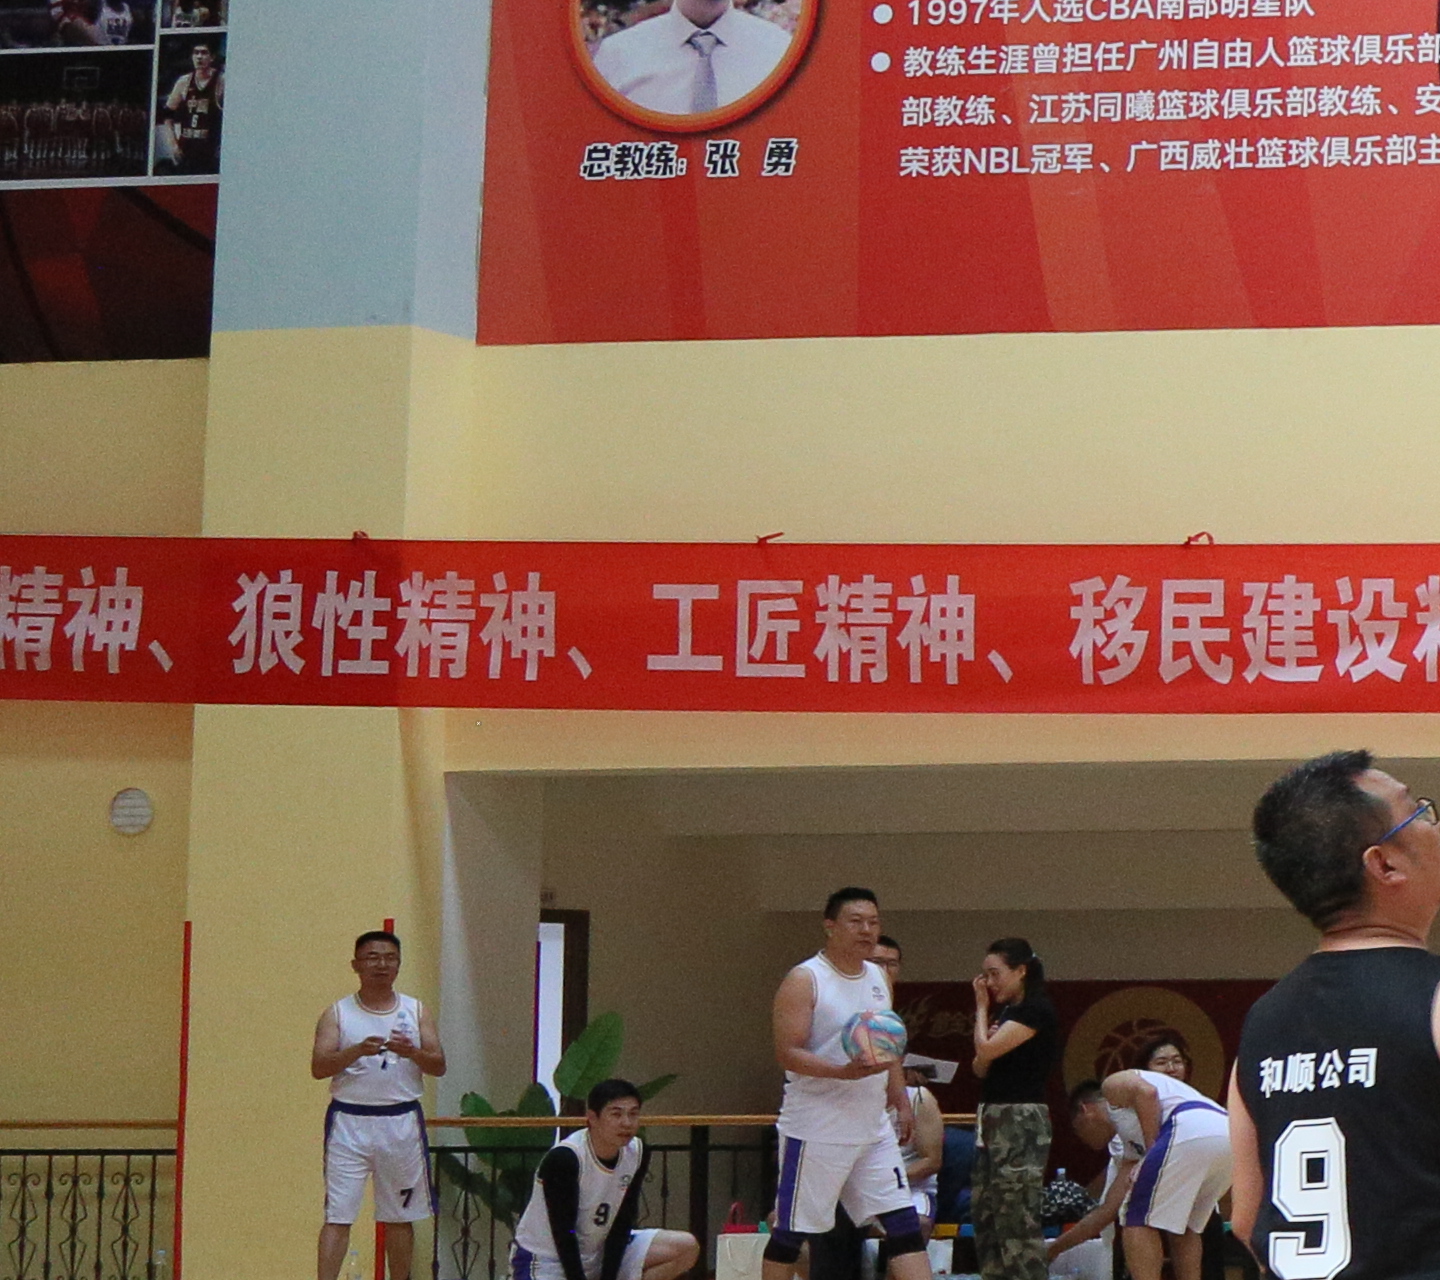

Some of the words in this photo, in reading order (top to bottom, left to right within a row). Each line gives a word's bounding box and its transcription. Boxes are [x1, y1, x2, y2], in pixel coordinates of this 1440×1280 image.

[1259, 1048, 1378, 1099] 和顺公司
[400, 1187, 414, 1208] 7
[594, 1202, 611, 1226] 9
